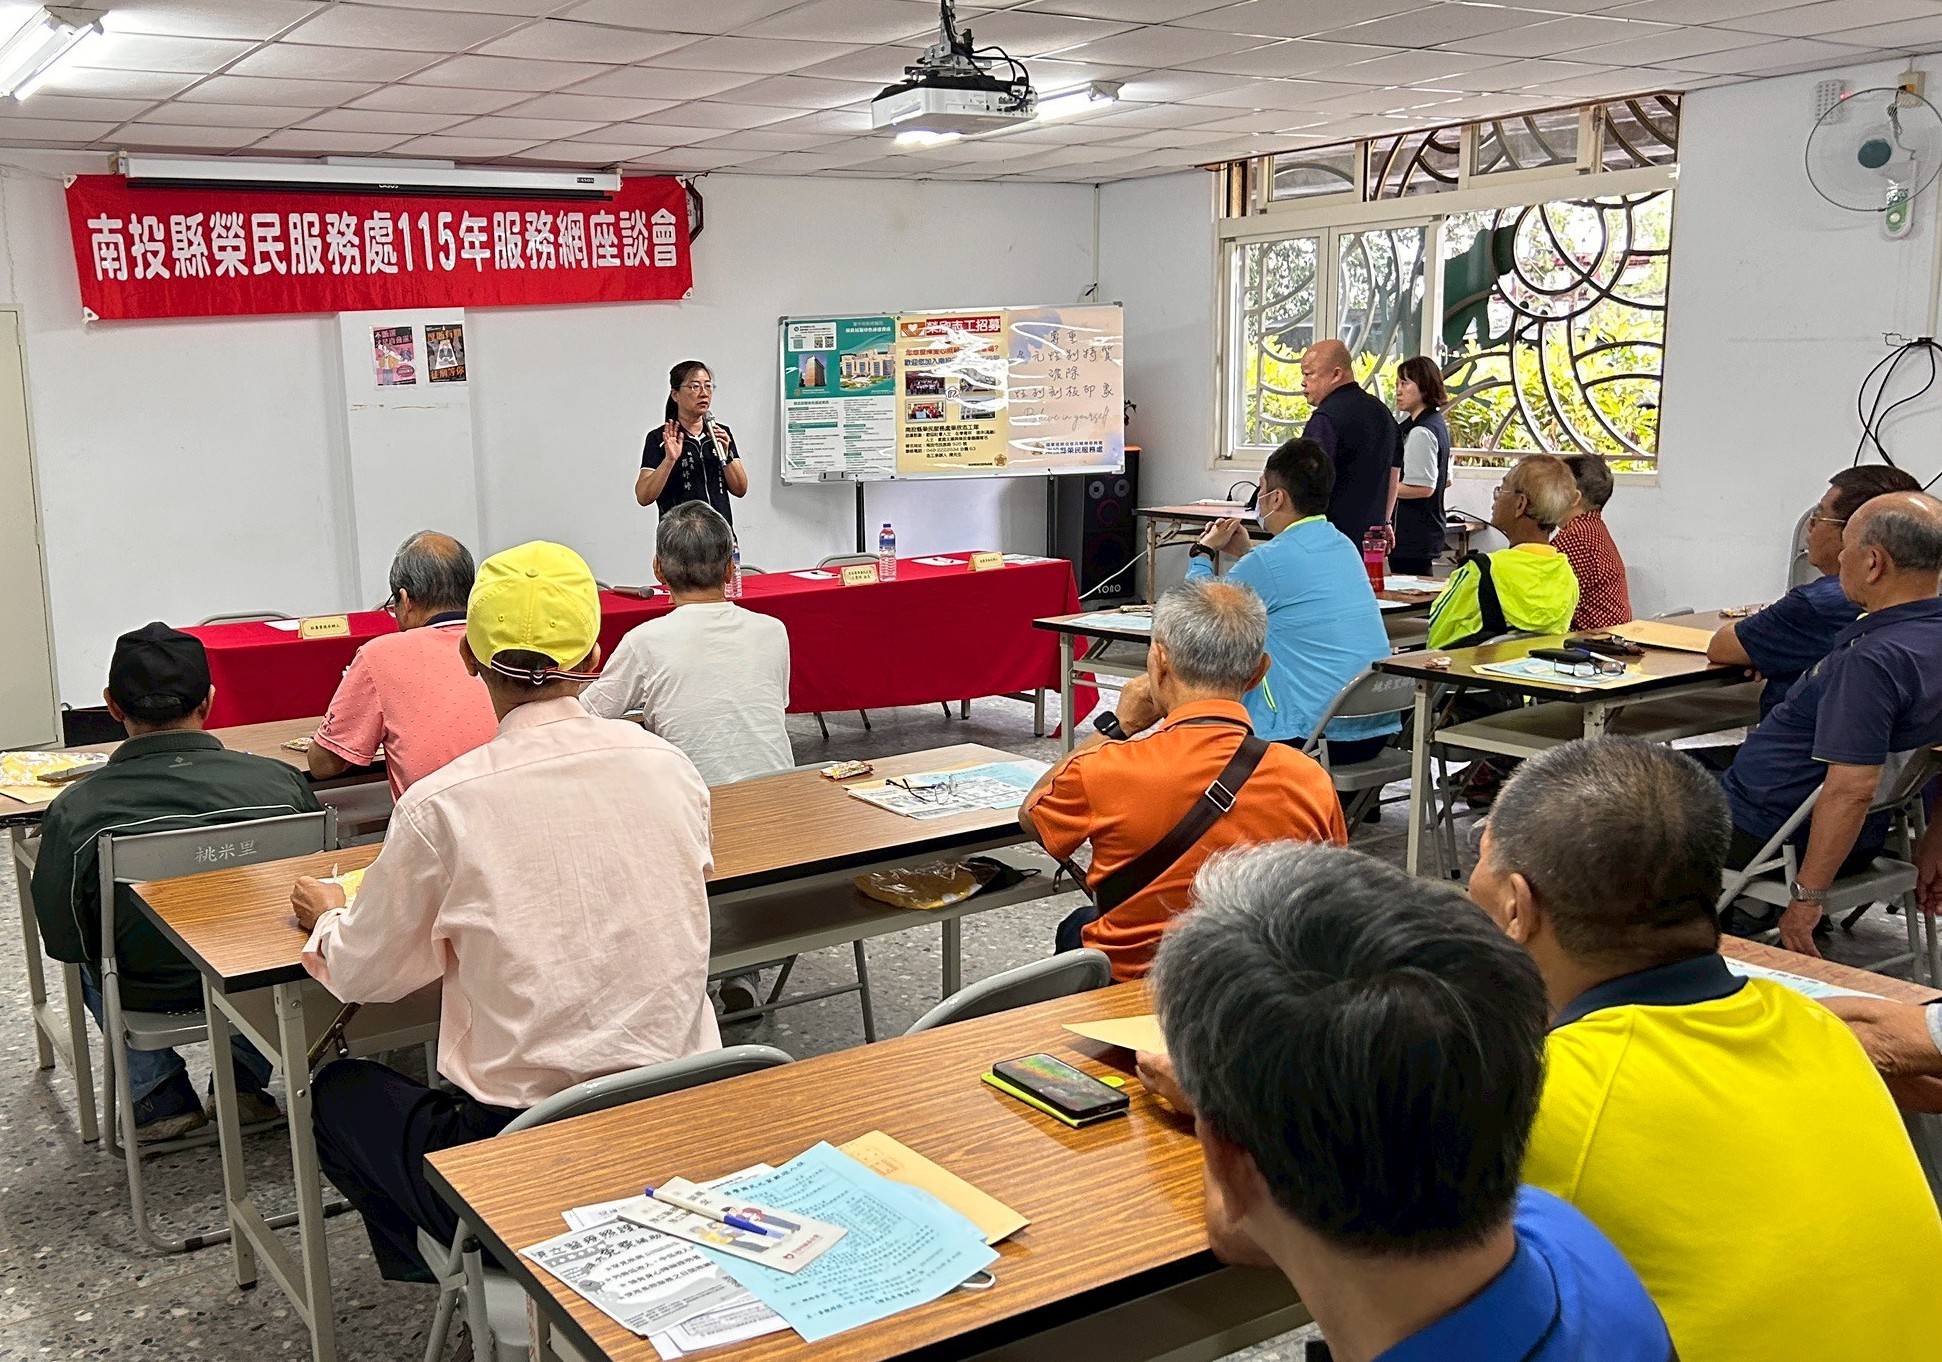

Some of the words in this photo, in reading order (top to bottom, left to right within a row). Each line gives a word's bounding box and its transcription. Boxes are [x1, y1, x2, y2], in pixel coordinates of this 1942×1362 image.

[87, 207, 677, 281] 南投縣榮民服務處115年服務網座談會
[194, 840, 257, 863] 桃米里
